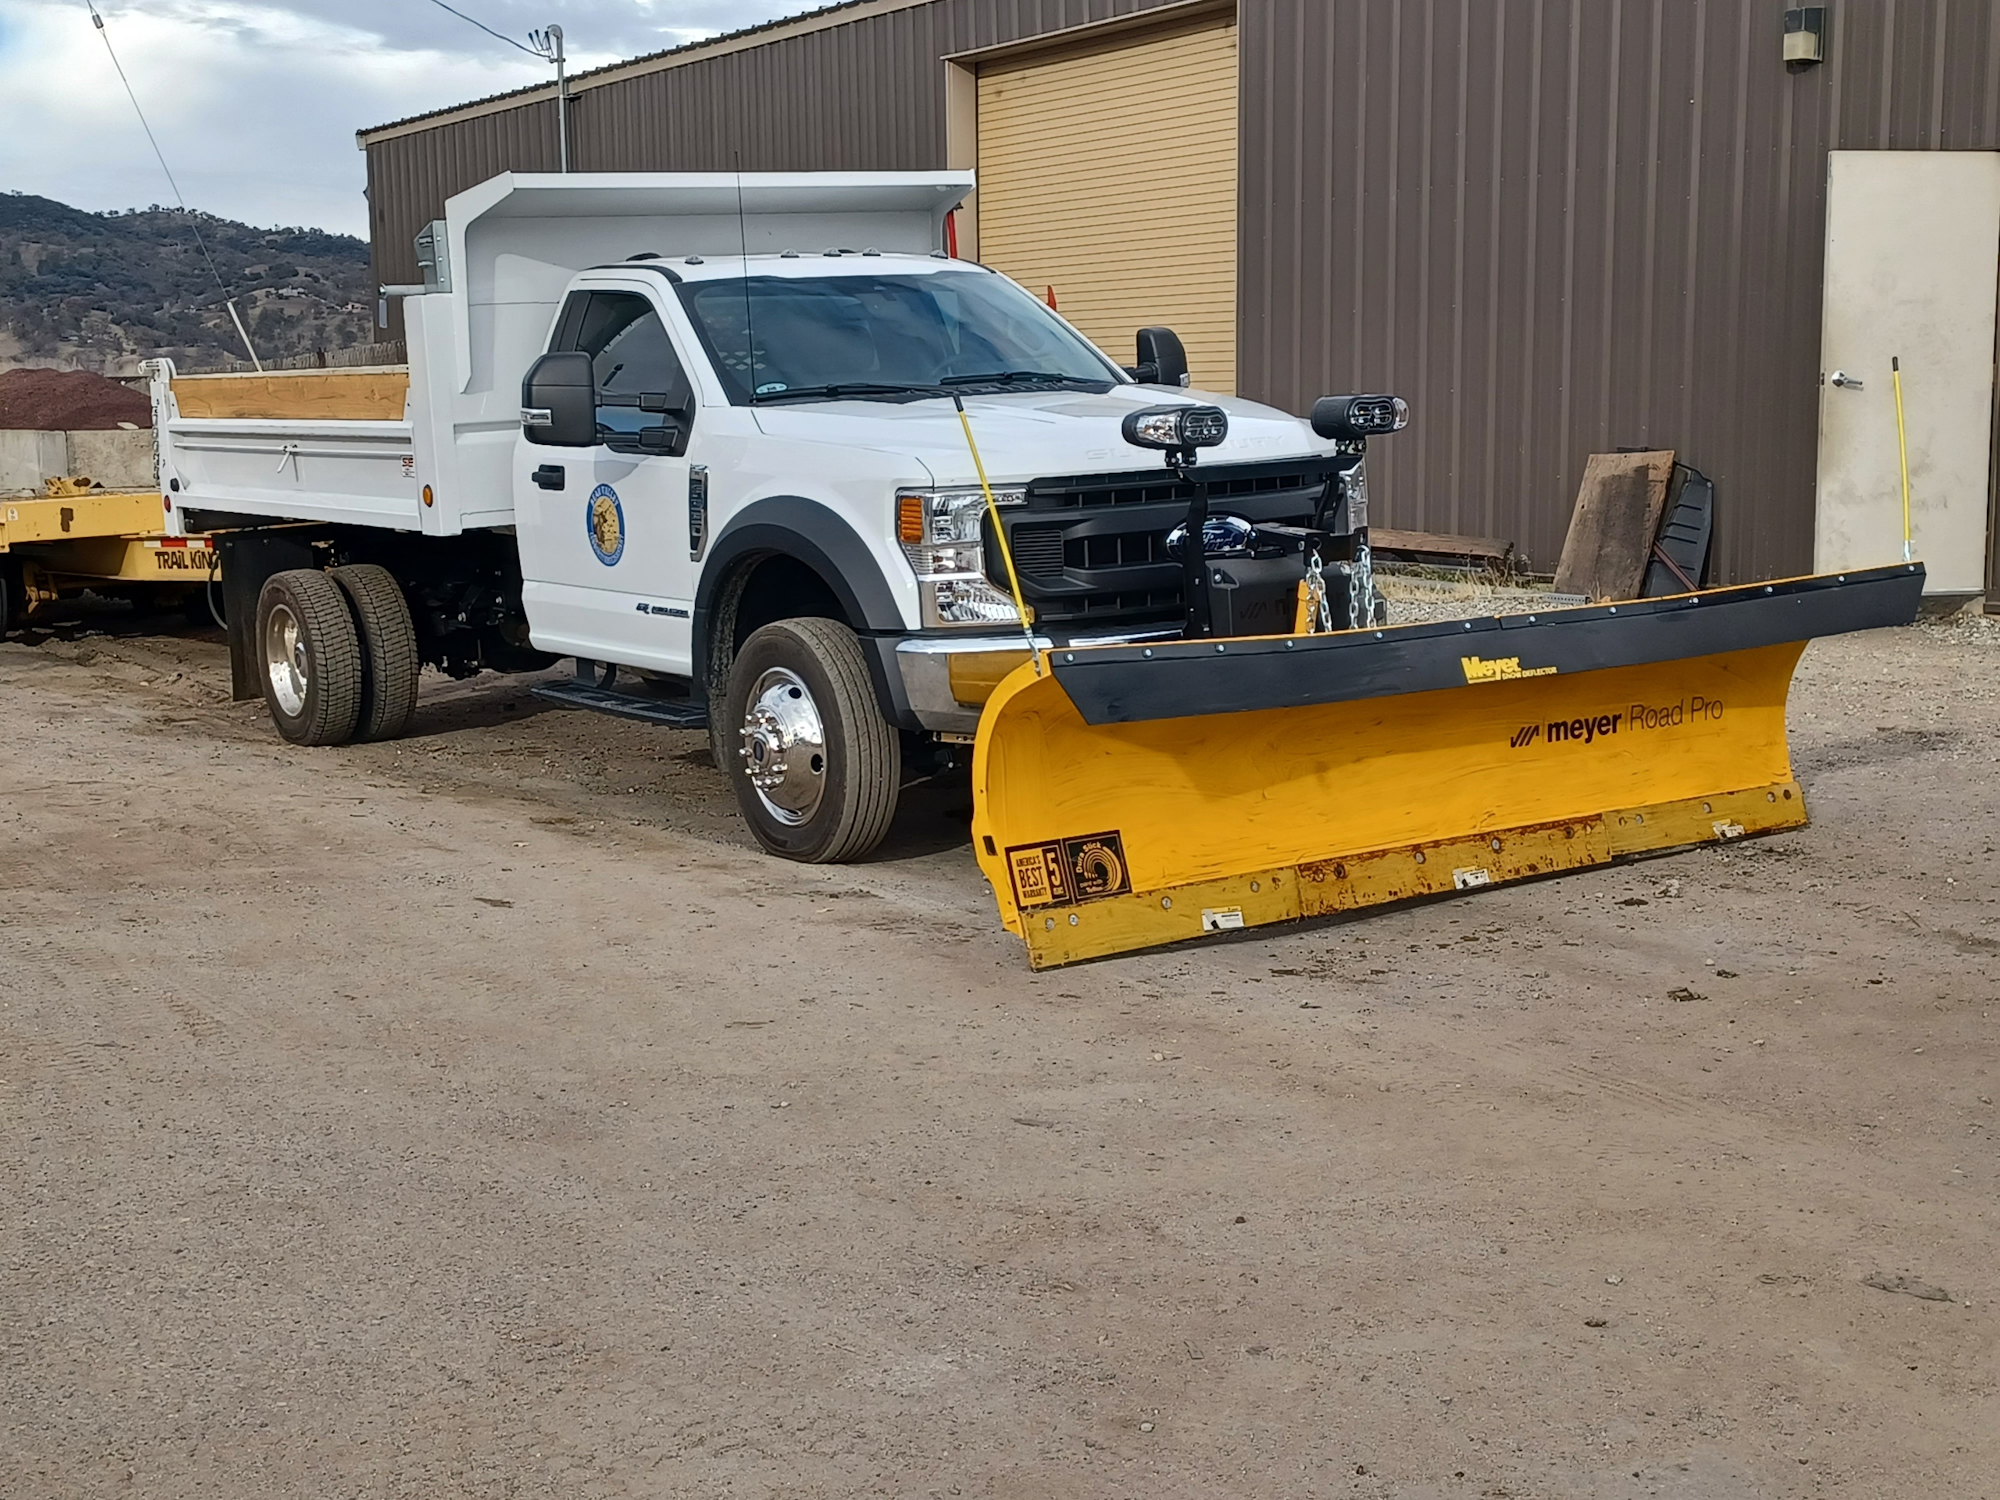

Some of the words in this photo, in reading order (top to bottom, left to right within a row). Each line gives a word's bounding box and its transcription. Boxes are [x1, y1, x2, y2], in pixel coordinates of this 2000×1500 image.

[1461, 656, 1522, 684] Meyer
[1522, 666, 1558, 678] DEFLECTOR
[1547, 712, 1623, 744] meyer
[1630, 698, 1684, 731] Road
[1691, 696, 1724, 722] Pro
[1046, 852, 1061, 886] 5
[1075, 852, 1085, 873] Dura
[1082, 841, 1102, 852] Slick
[1018, 866, 1045, 889] BEST
